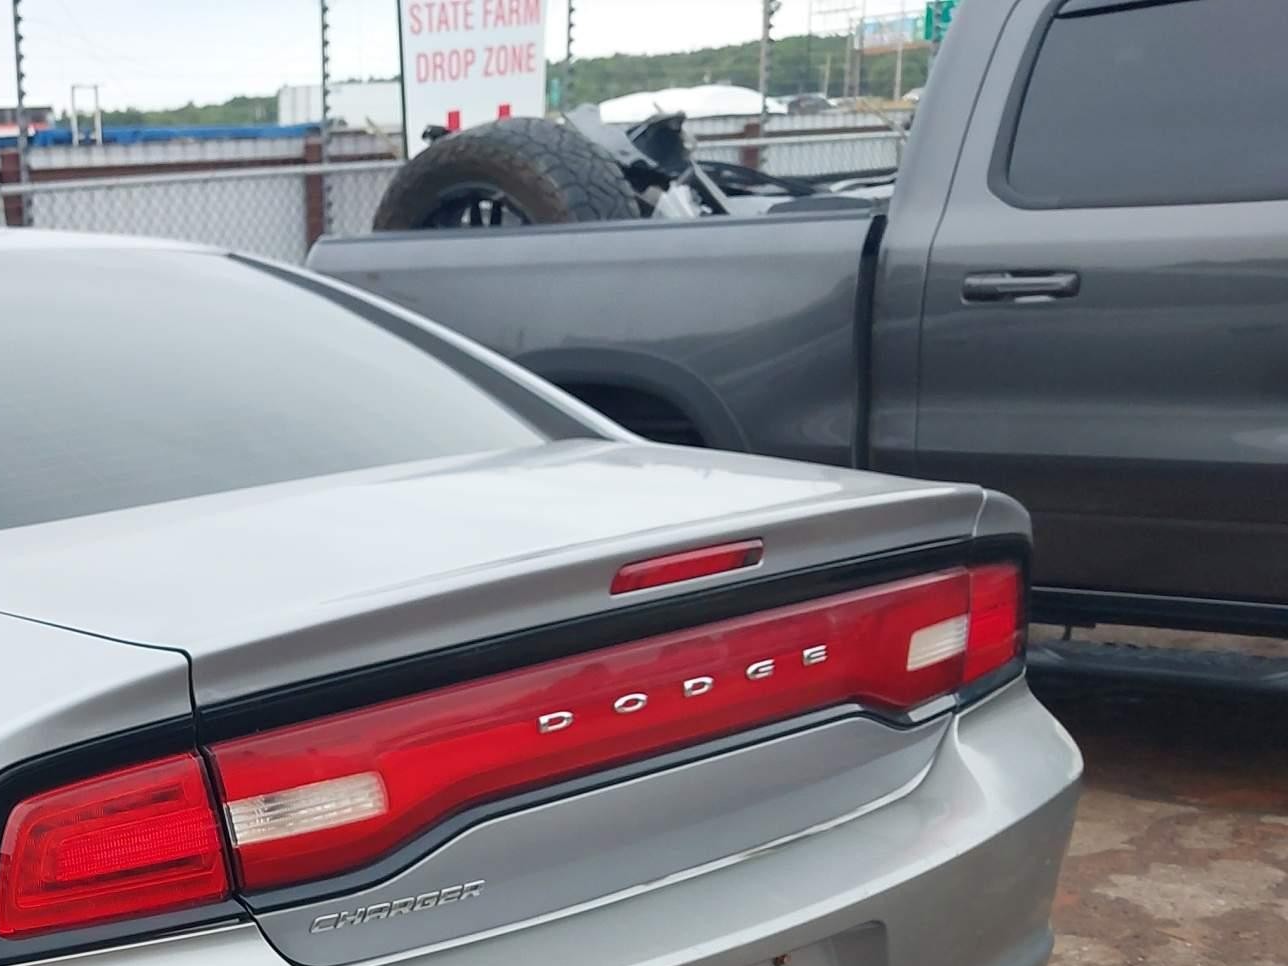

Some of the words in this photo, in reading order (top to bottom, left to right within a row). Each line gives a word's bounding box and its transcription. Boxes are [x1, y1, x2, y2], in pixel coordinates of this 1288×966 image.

[409, 1, 475, 36] STATE
[481, 0, 542, 29] FARM
[415, 48, 477, 84] DROP
[482, 42, 538, 78] ZONE
[538, 645, 829, 734] DODGE
[310, 879, 486, 934] CHARGER
